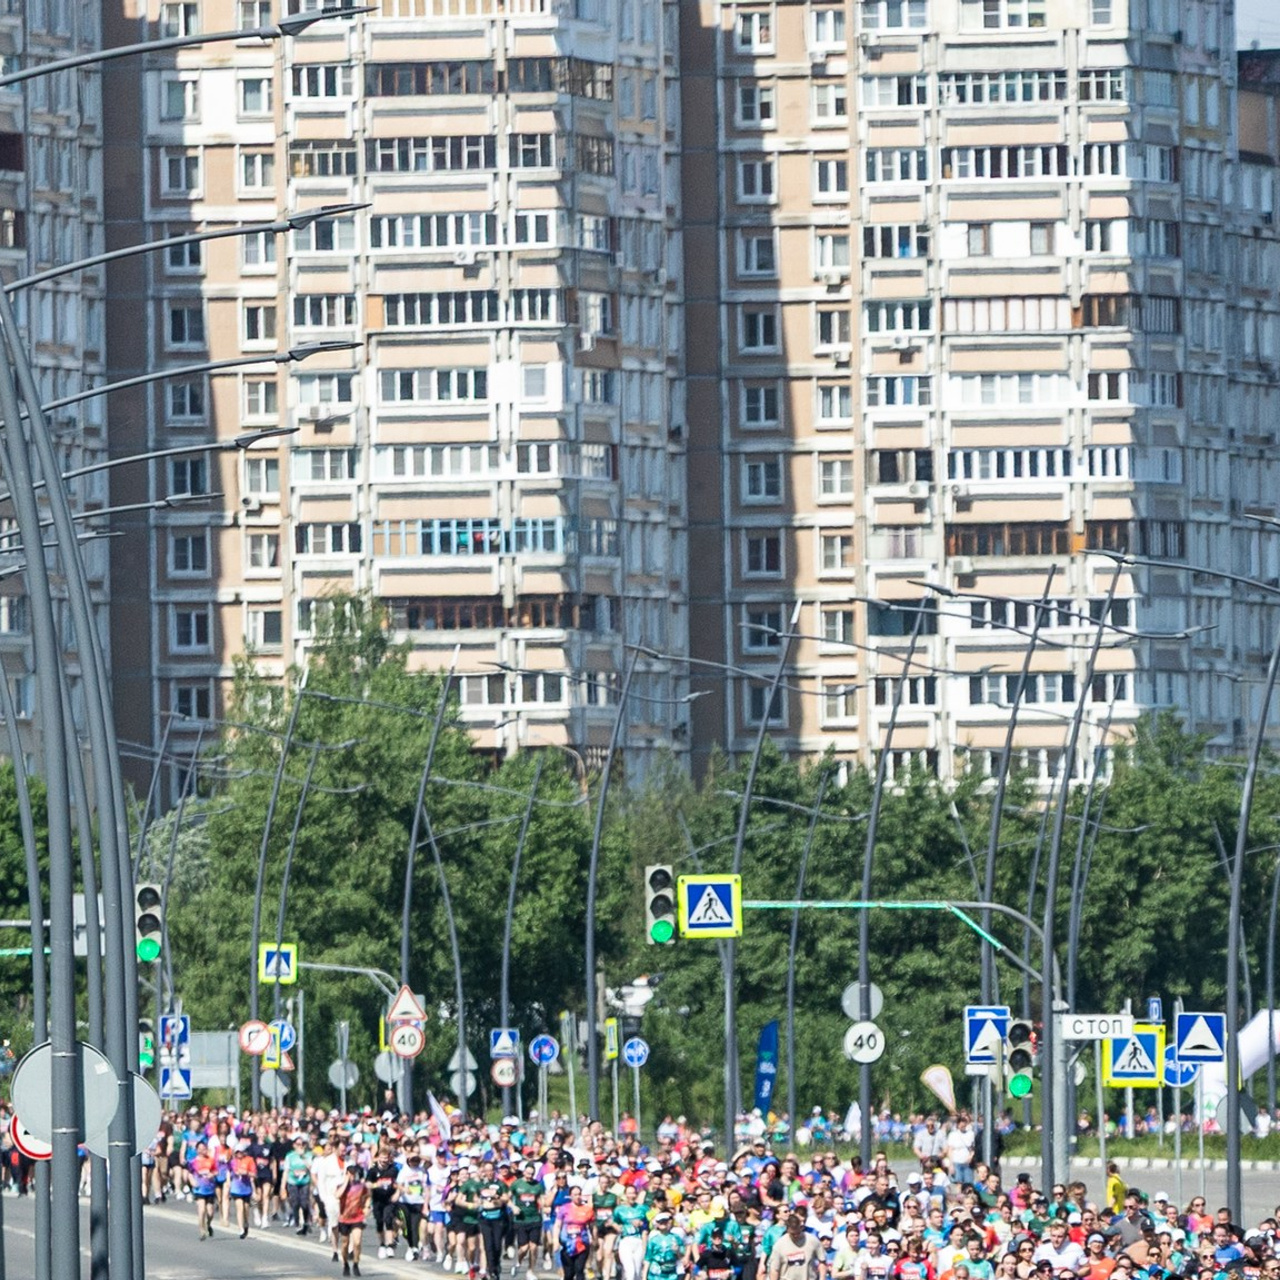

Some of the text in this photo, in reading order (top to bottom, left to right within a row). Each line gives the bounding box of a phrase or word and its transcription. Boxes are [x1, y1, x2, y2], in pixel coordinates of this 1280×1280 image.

[1072, 1019, 1123, 1035] СТОП
[398, 1033, 417, 1047] 40
[853, 1033, 877, 1050] 40
